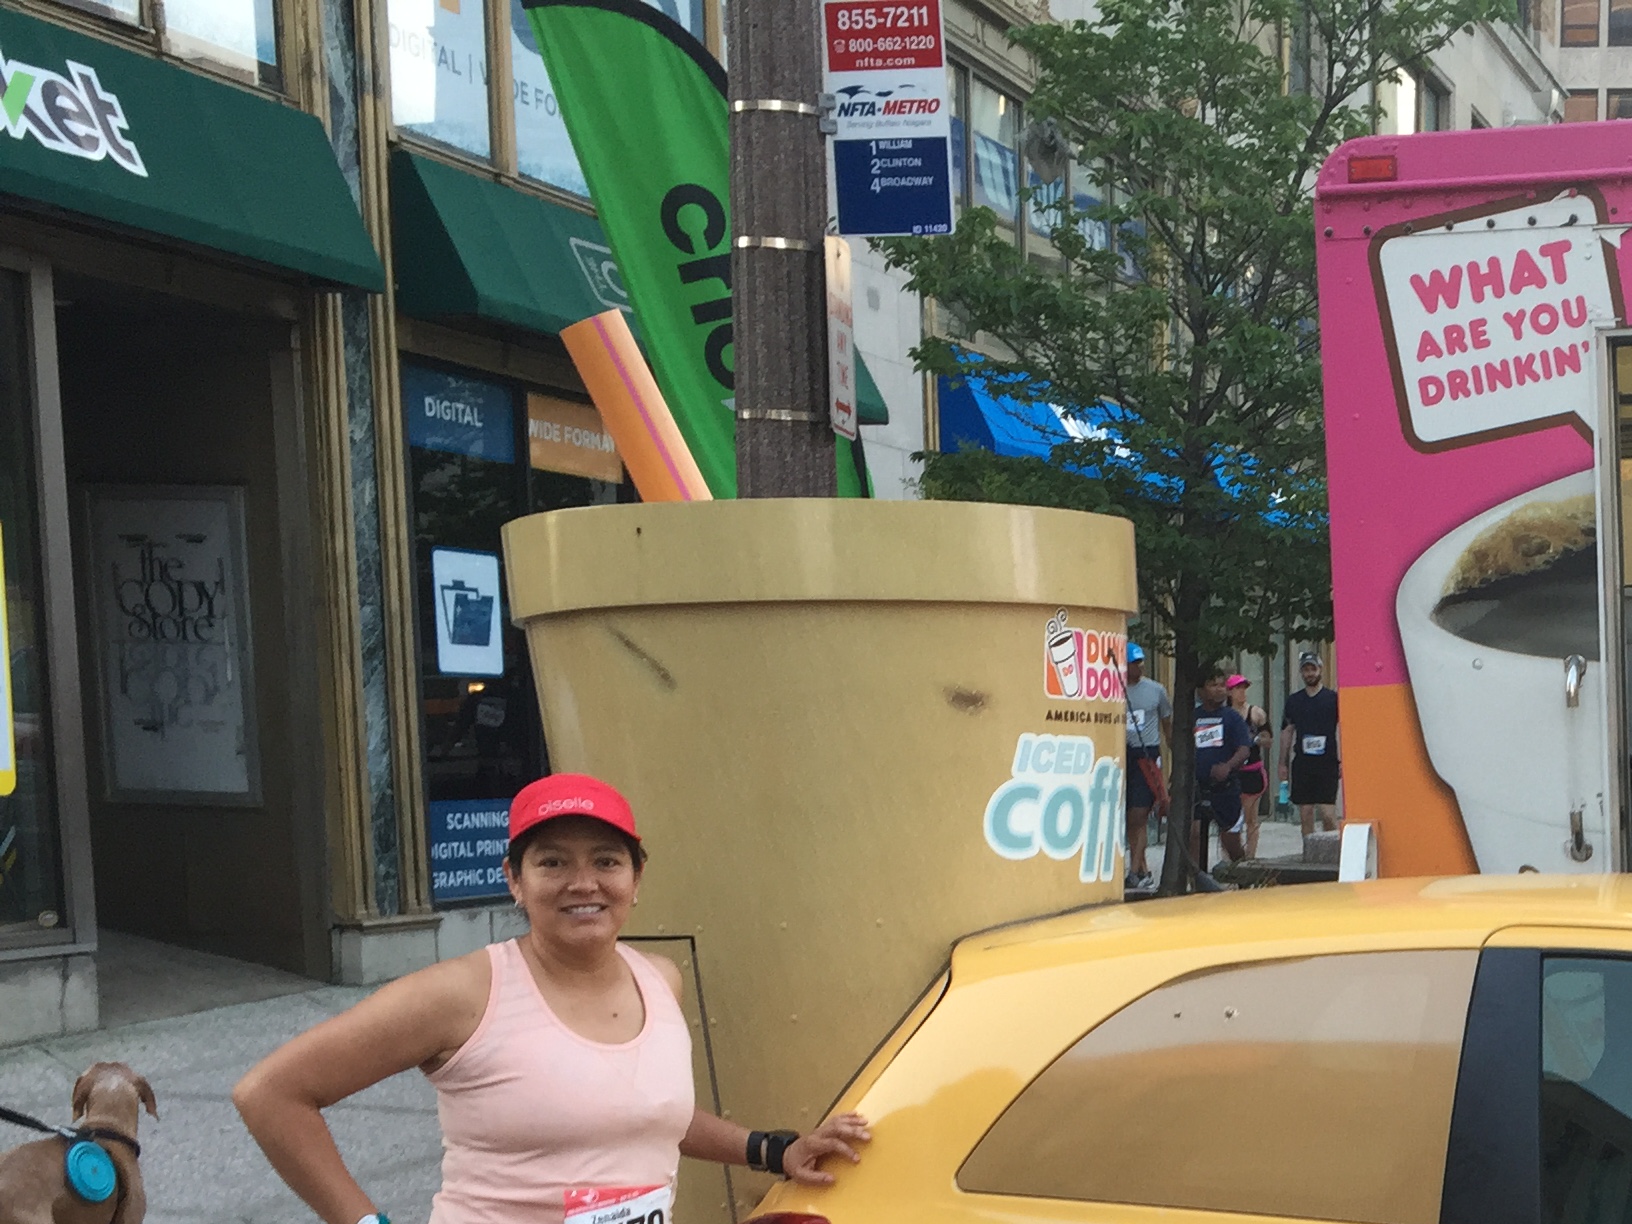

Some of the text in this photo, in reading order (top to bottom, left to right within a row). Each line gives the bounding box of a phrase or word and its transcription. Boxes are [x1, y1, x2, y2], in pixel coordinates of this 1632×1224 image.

[837, 6, 929, 31] 855-7211
[848, 35, 935, 53] 800-662-1220
[855, 56, 915, 68] nfta.com
[869, 140, 876, 156] 1
[870, 157, 922, 174] 2 CLINTON
[870, 176, 934, 194] 4 BROADWAY
[1409, 239, 1572, 315] WHAT
[1416, 295, 1588, 363] ARE YOU
[1418, 340, 1590, 407] DRINKIN'
[424, 396, 484, 428] DIGITAL
[529, 418, 561, 443] WIDE
[1045, 709, 1092, 723] AMERICA
[1017, 739, 1092, 775] ICED
[446, 810, 509, 831] SCANNING
[991, 764, 1126, 874] coff
